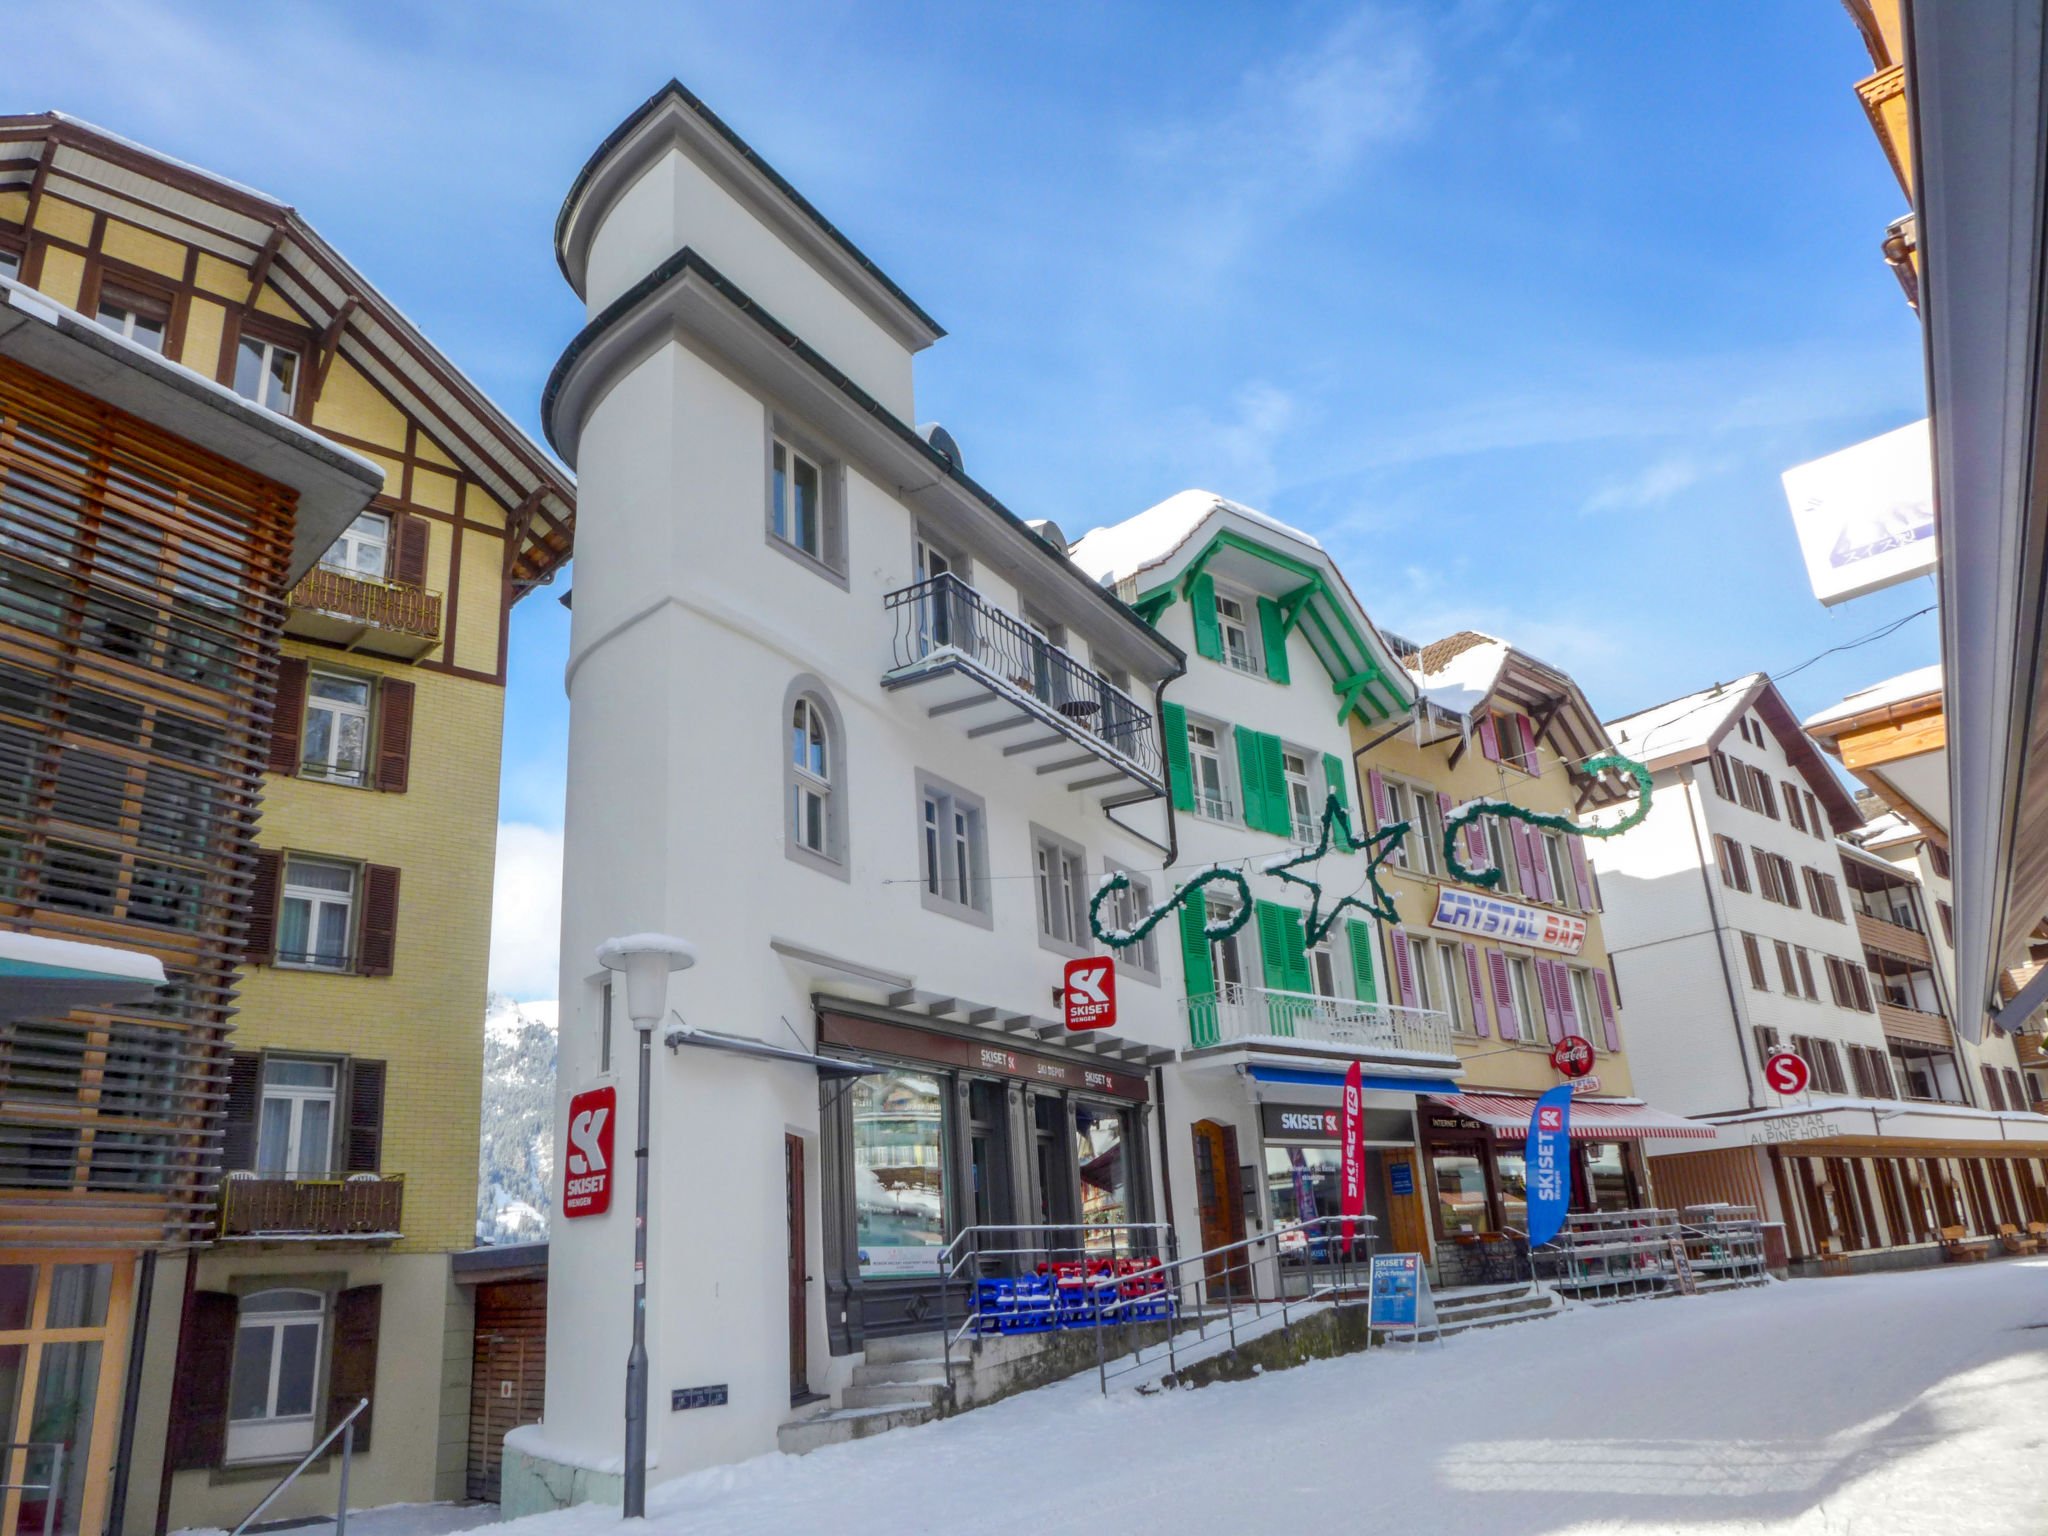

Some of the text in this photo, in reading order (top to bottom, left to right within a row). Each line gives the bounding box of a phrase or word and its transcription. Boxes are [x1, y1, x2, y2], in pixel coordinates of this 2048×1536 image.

[1437, 891, 1586, 951] CRYSTAL BAR
[1070, 1003, 1110, 1017] SKISET
[1070, 1015, 1096, 1024] WENGEN
[980, 1049, 1007, 1066] SKISET
[1085, 1071, 1106, 1086] SKISET
[1775, 1058, 1798, 1090] S
[1281, 1112, 1323, 1131] SKISET
[1763, 1114, 1825, 1132] SUNSTAR
[1751, 1123, 1845, 1145] ALPINE HOTEL
[1346, 1114, 1358, 1199] SKISET
[1538, 1131, 1555, 1201] SKISET
[567, 1175, 606, 1197] SKISET
[567, 1196, 592, 1208] WENGEN
[1375, 1258, 1404, 1268] SKISET
